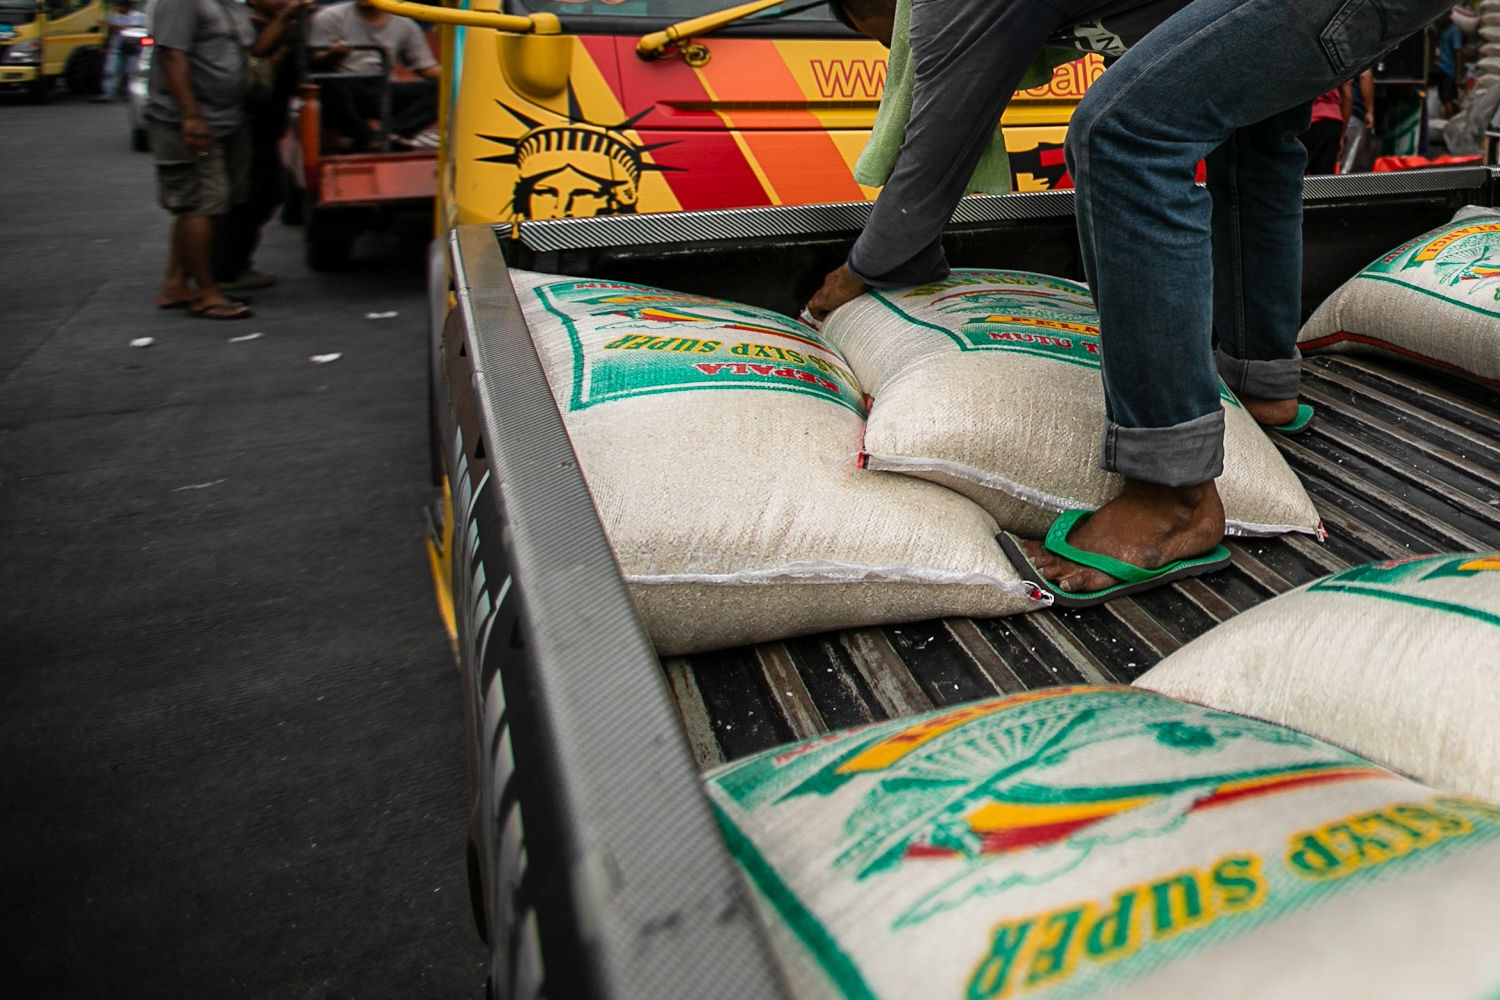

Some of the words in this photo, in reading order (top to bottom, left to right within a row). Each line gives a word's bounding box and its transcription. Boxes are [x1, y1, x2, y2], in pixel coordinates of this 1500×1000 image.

[603, 333, 723, 355] SUPER
[988, 331, 1073, 349] MUTU
[730, 341, 808, 366] SLYP
[696, 362, 841, 395] KEPALA
[963, 851, 1270, 1000] SUPER
